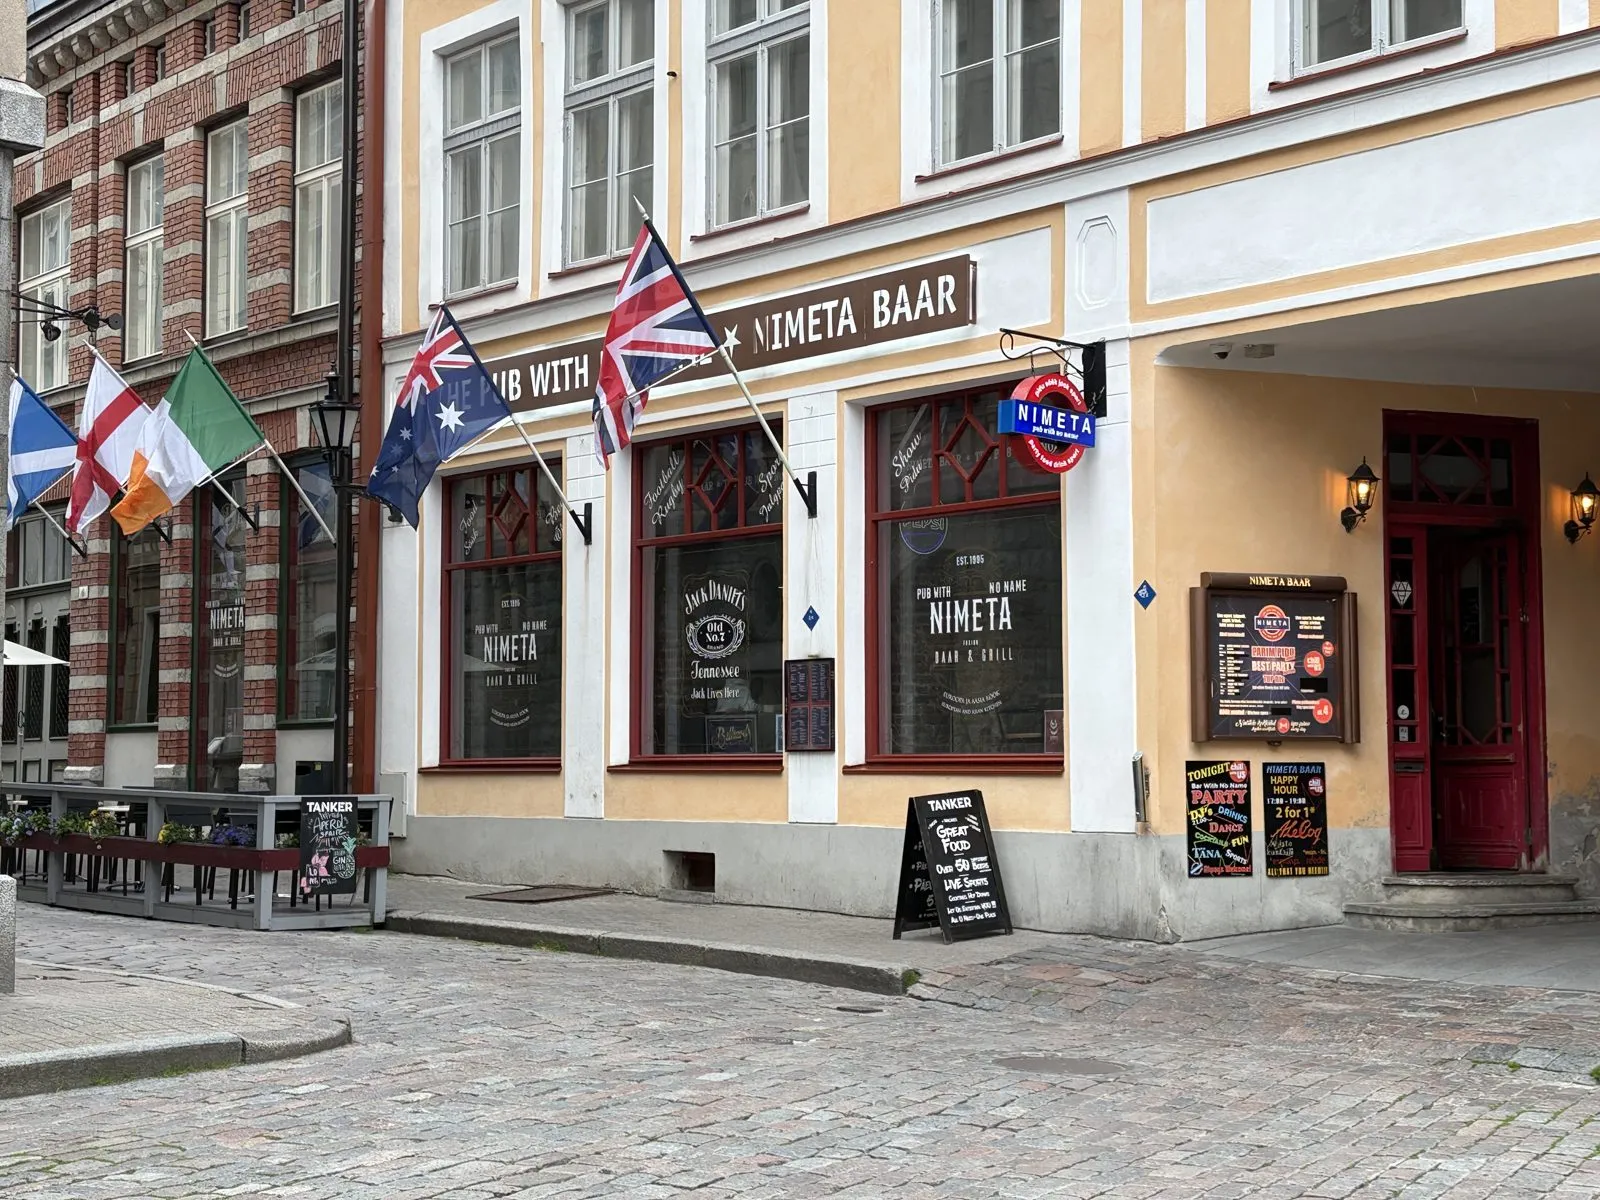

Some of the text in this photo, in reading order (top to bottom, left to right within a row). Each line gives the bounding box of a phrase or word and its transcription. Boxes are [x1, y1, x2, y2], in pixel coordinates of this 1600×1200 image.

[753, 274, 957, 354] NIMETA BAAR
[529, 353, 589, 398] WITH
[1018, 403, 1092, 435] NIMETA
[892, 432, 922, 477] Show
[1028, 439, 1041, 458] party
[643, 451, 682, 509] Football
[899, 462, 923, 493] Pidu
[651, 478, 685, 525] Rugby
[460, 499, 478, 534] Food
[1250, 576, 1311, 587] NIMETA BAAR
[917, 580, 1027, 600] PUB WITH NO NAME
[685, 586, 708, 615] JACK
[210, 606, 244, 630] NIMETA
[930, 597, 1012, 634] NIMETA
[475, 620, 547, 634] PUB WITH NO NAME
[707, 622, 723, 632] Old
[483, 633, 538, 662] NIMETA
[967, 649, 974, 663] &
[981, 647, 1013, 662] GRILL
[690, 660, 740, 680] Tennessee
[1252, 660, 1295, 673] BEST PARTY
[690, 686, 740, 699] Jack Lives Here
[1187, 762, 1230, 782] TONIGHT
[1230, 763, 1244, 771] chill
[1266, 765, 1322, 774] NIMETA BAAR
[1270, 775, 1299, 785] HAPPY
[1308, 778, 1321, 787] chill
[1191, 789, 1248, 805] PARTY
[1273, 785, 1298, 795] HOUR
[307, 801, 353, 813] TANKER
[927, 797, 973, 812] TANKER
[1275, 807, 1283, 818] 2
[1284, 806, 1301, 818] for
[1218, 806, 1248, 824] DRINKS
[936, 824, 970, 840] GREAT
[1209, 822, 1244, 833] DANCE
[941, 839, 971, 855] FOOD
[1231, 835, 1249, 848] FUN
[333, 856, 346, 865] GIN
[1225, 849, 1248, 865] SPORTS
[936, 864, 954, 874] OVER
[954, 858, 970, 873] 50
[943, 878, 963, 892] LIVE
[963, 877, 989, 888] SPORTS
